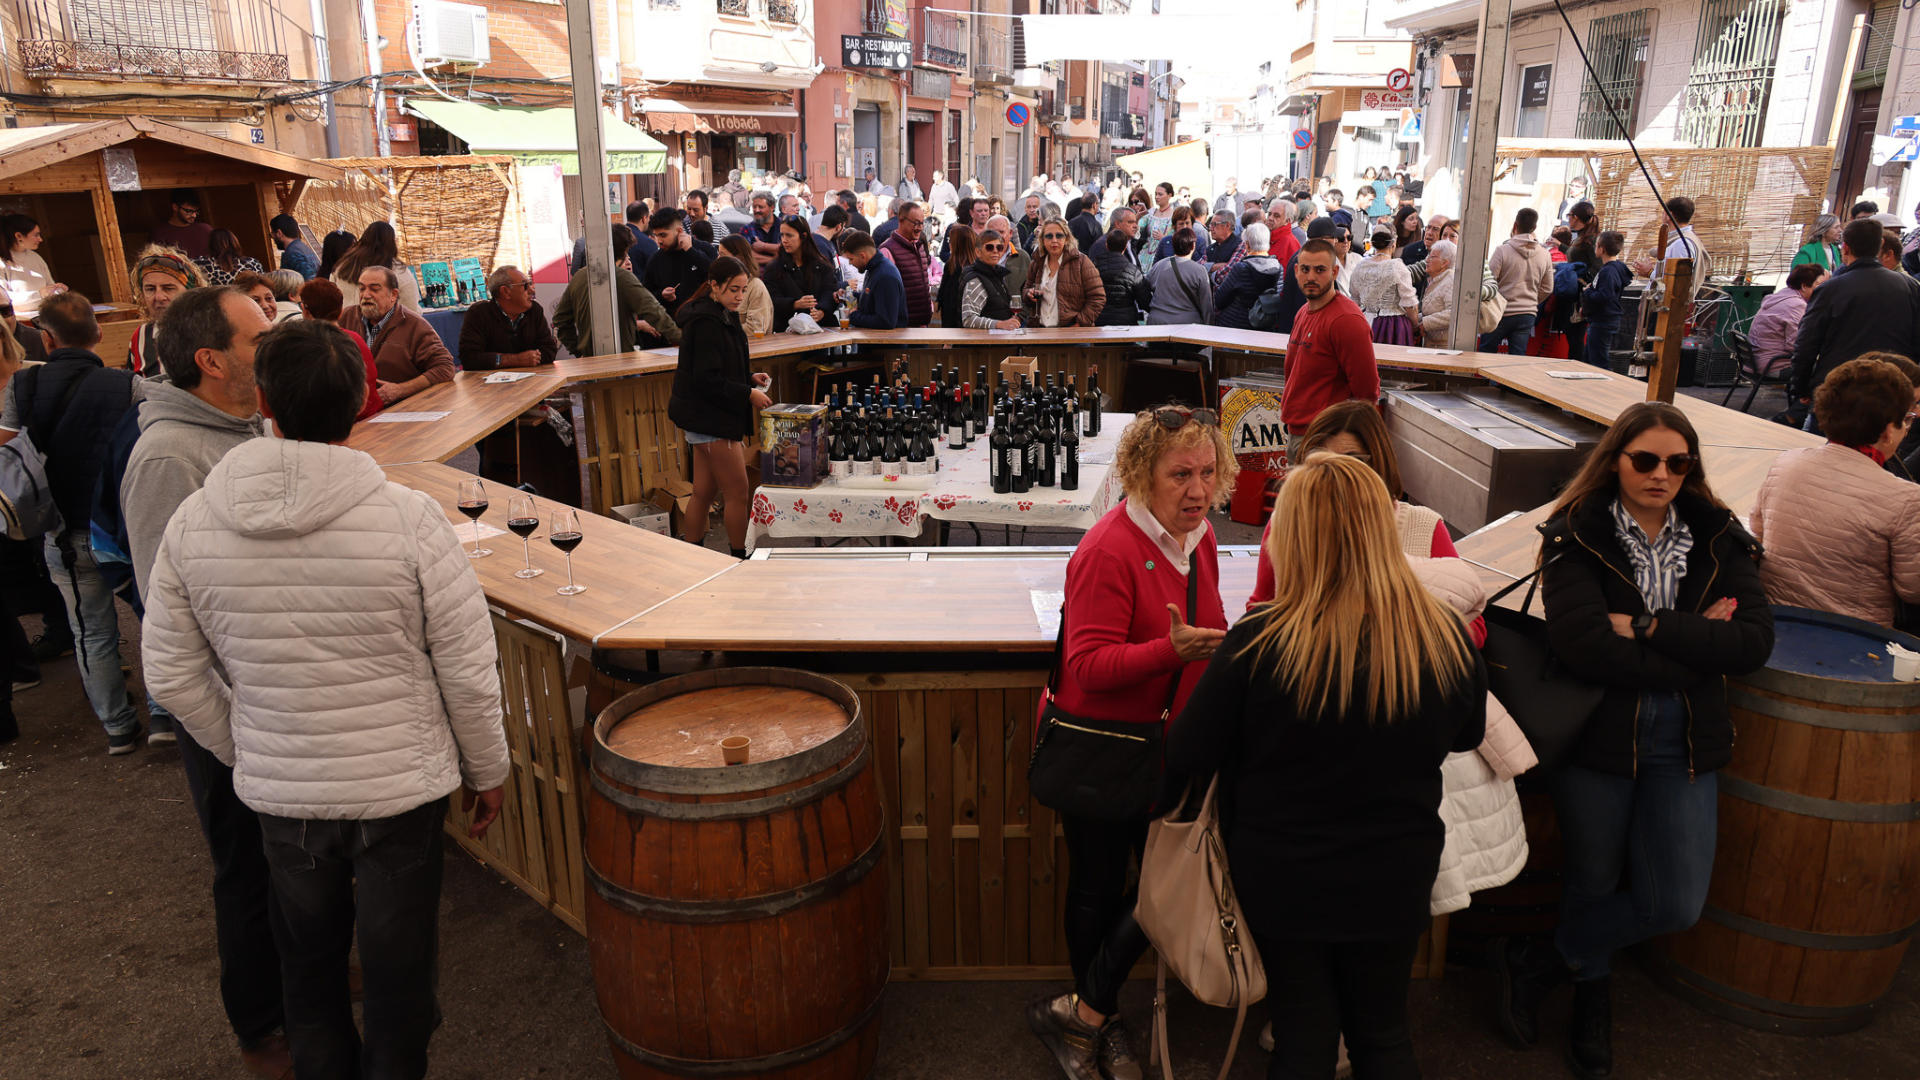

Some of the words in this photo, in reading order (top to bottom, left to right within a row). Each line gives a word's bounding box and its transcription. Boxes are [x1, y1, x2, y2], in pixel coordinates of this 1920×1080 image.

[845, 38, 860, 49] BAR
[864, 39, 911, 54] RESTAURANTE
[865, 52, 892, 66] L'Hostal
[694, 113, 710, 129] La
[713, 114, 761, 130] Trobada
[251, 130, 264, 142] 42
[607, 152, 645, 172] Font
